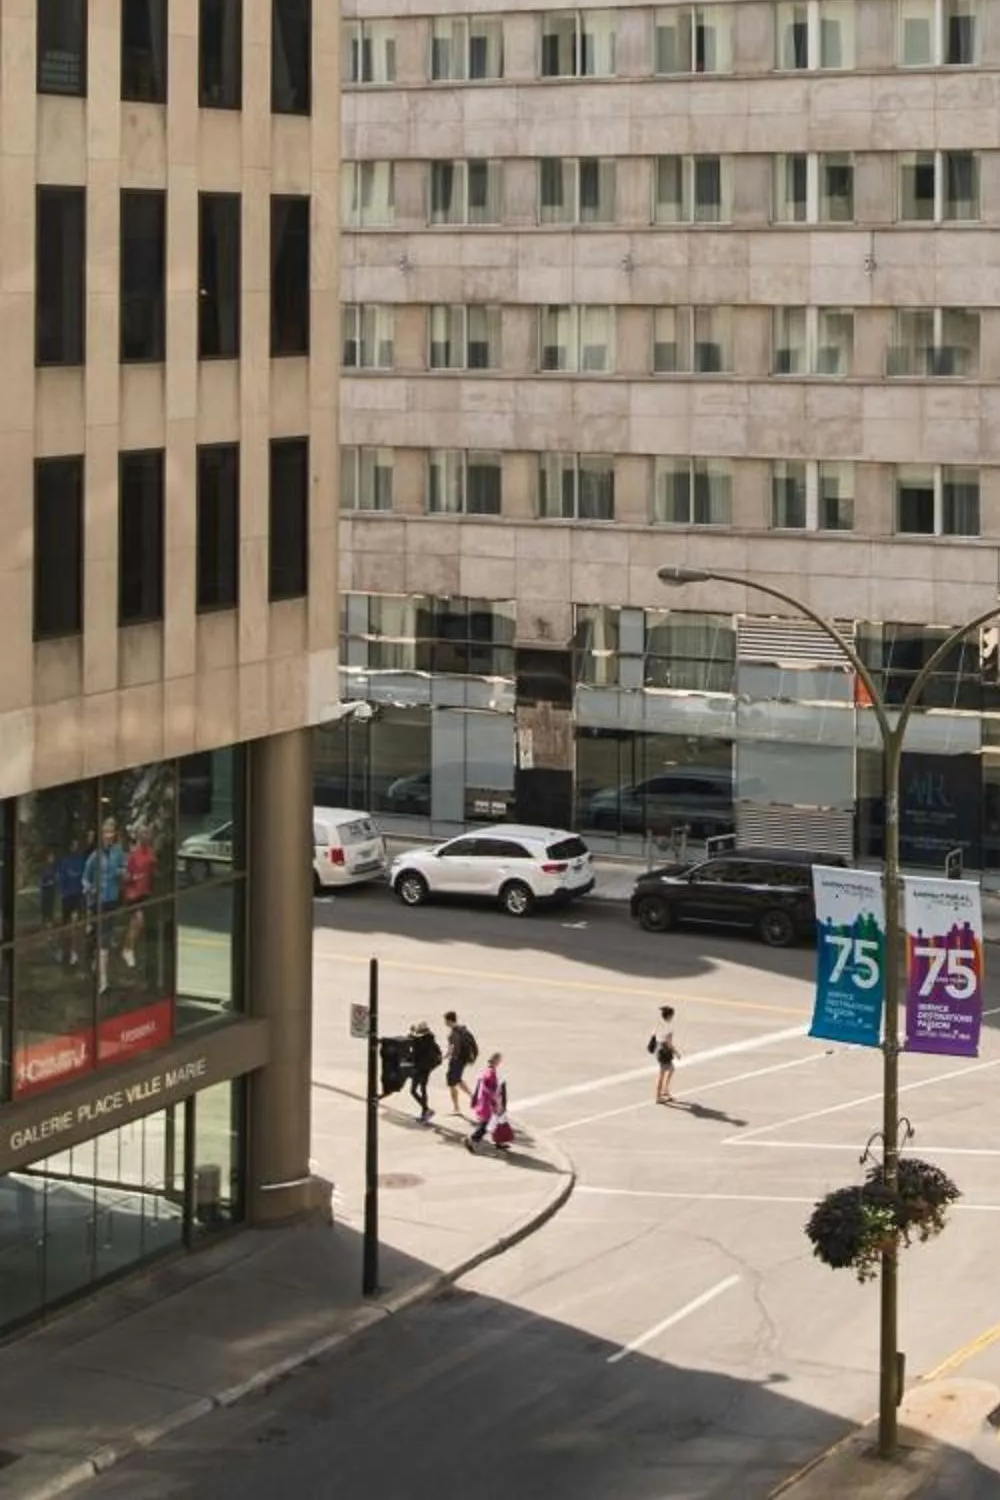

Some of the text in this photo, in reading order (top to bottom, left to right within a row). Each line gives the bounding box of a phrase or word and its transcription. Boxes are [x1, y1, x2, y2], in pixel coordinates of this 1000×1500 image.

[825, 934, 880, 990] 75
[913, 946, 977, 999] 75
[10, 1057, 208, 1150] GALERIE PLACE VILLE MARIE
